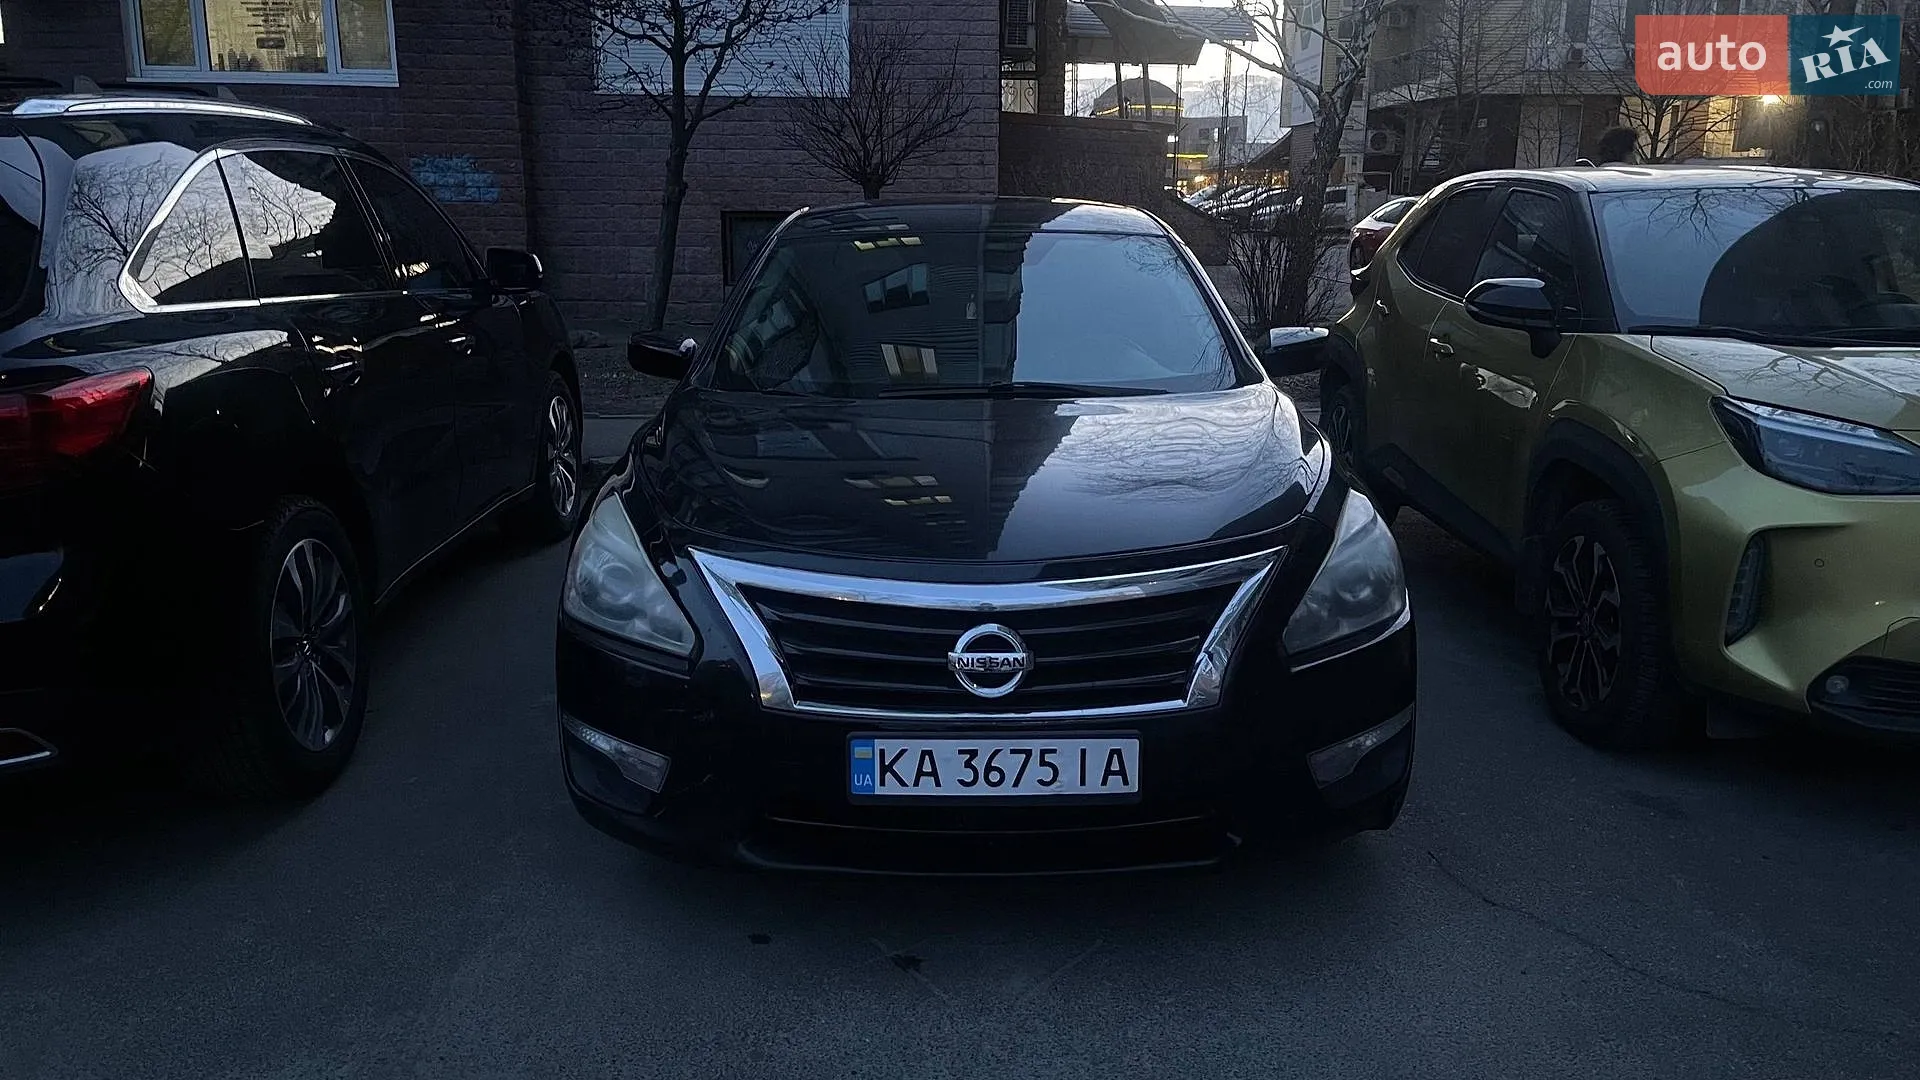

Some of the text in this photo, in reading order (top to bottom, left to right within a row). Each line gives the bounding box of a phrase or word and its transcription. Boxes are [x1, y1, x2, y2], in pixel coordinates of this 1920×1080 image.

[956, 657, 1025, 668] NISSAN
[878, 748, 1130, 788] KA 3675 IA
[854, 775, 873, 786] UA
